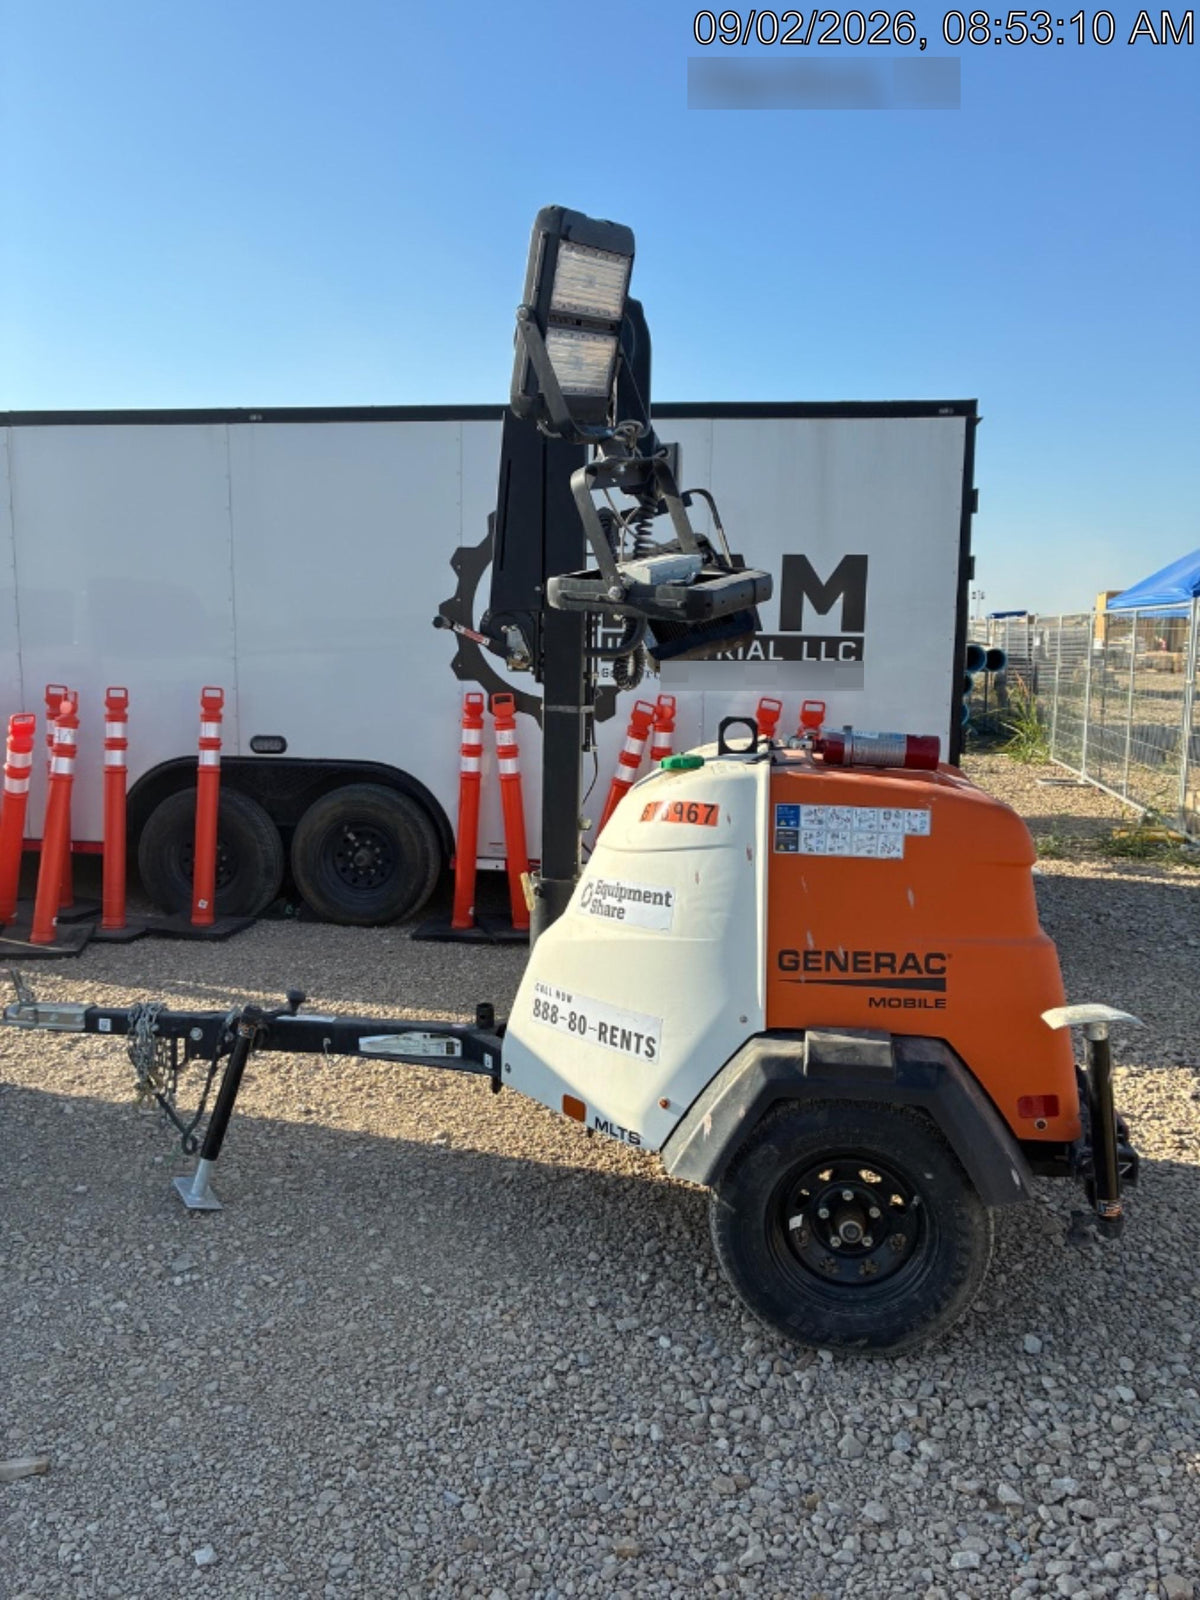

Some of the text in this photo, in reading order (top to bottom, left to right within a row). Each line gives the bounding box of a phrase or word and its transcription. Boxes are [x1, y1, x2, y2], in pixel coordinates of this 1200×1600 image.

[802, 640, 856, 662] LLC
[595, 879, 672, 907] Equipment
[778, 949, 947, 975] GENERAC
[556, 989, 573, 1003] NOW
[868, 997, 947, 1009] MOBILE
[533, 998, 657, 1059] 888-80-RENTS
